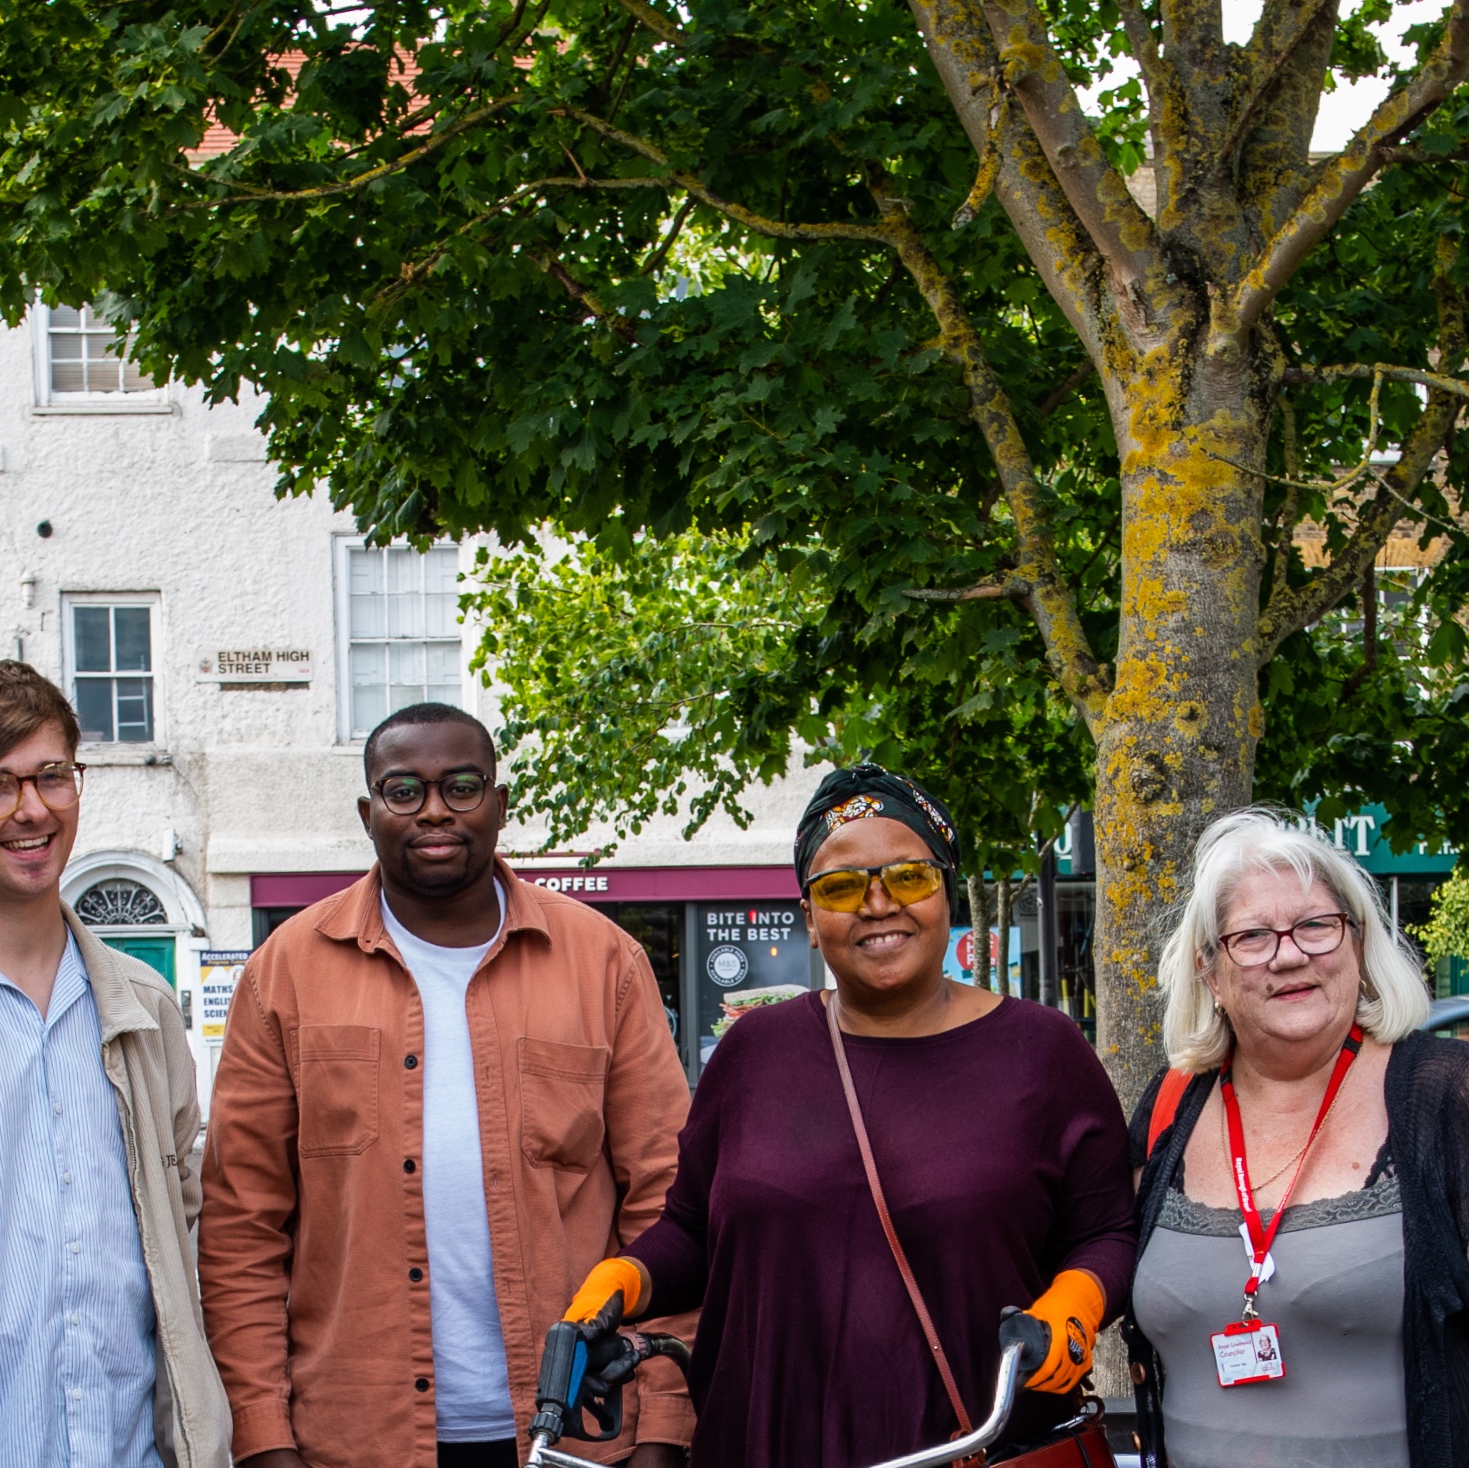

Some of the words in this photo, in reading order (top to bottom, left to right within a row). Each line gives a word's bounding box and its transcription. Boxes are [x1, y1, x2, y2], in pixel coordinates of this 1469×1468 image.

[218, 651, 272, 662] ELTHAM
[276, 651, 310, 662] HIGH
[218, 663, 271, 674] STREET
[533, 876, 609, 892] COFFEE
[707, 912, 745, 926] BITE
[751, 911, 795, 925] INTO
[707, 928, 741, 942] THE
[747, 928, 791, 941] BEST
[202, 952, 248, 960] ACCELERATED
[718, 960, 737, 968] M&S
[203, 985, 233, 994] MATHS
[204, 1010, 227, 1018] SCIEN
